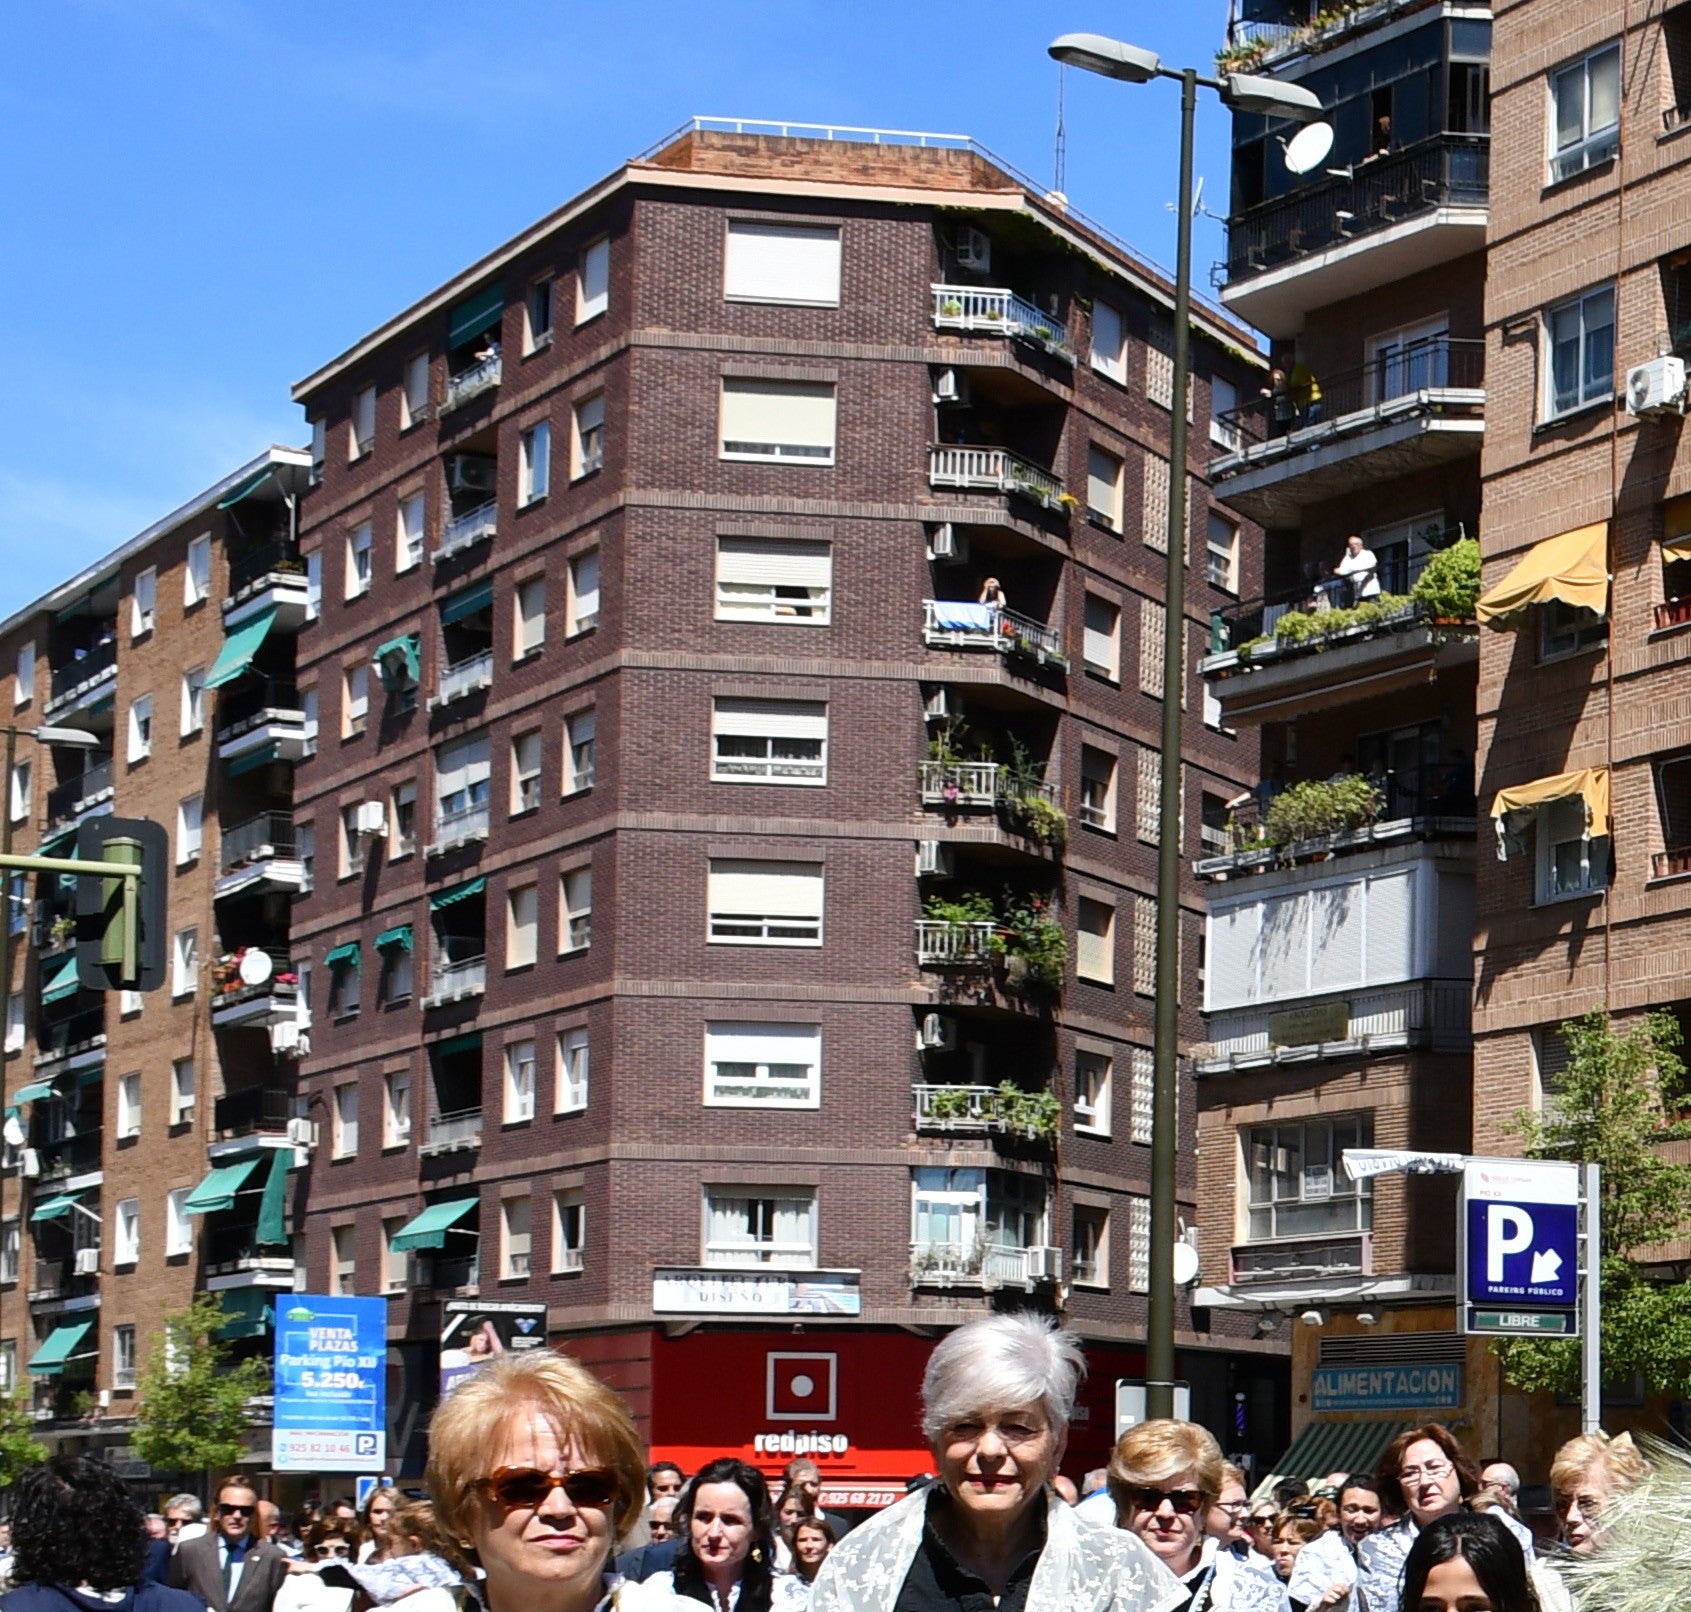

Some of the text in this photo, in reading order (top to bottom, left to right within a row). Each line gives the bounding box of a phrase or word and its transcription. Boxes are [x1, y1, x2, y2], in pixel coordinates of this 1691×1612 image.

[1487, 1204, 1534, 1282] P
[1487, 1285, 1525, 1295] PARKING
[1499, 1312, 1540, 1328] LIBRE
[308, 1327, 353, 1340] VENTA
[308, 1340, 359, 1353] PLAZAS
[280, 1353, 331, 1369] Parking
[1314, 1369, 1455, 1396] ALIMENTACION
[289, 1443, 306, 1452] 925
[754, 1429, 849, 1455] redpiso
